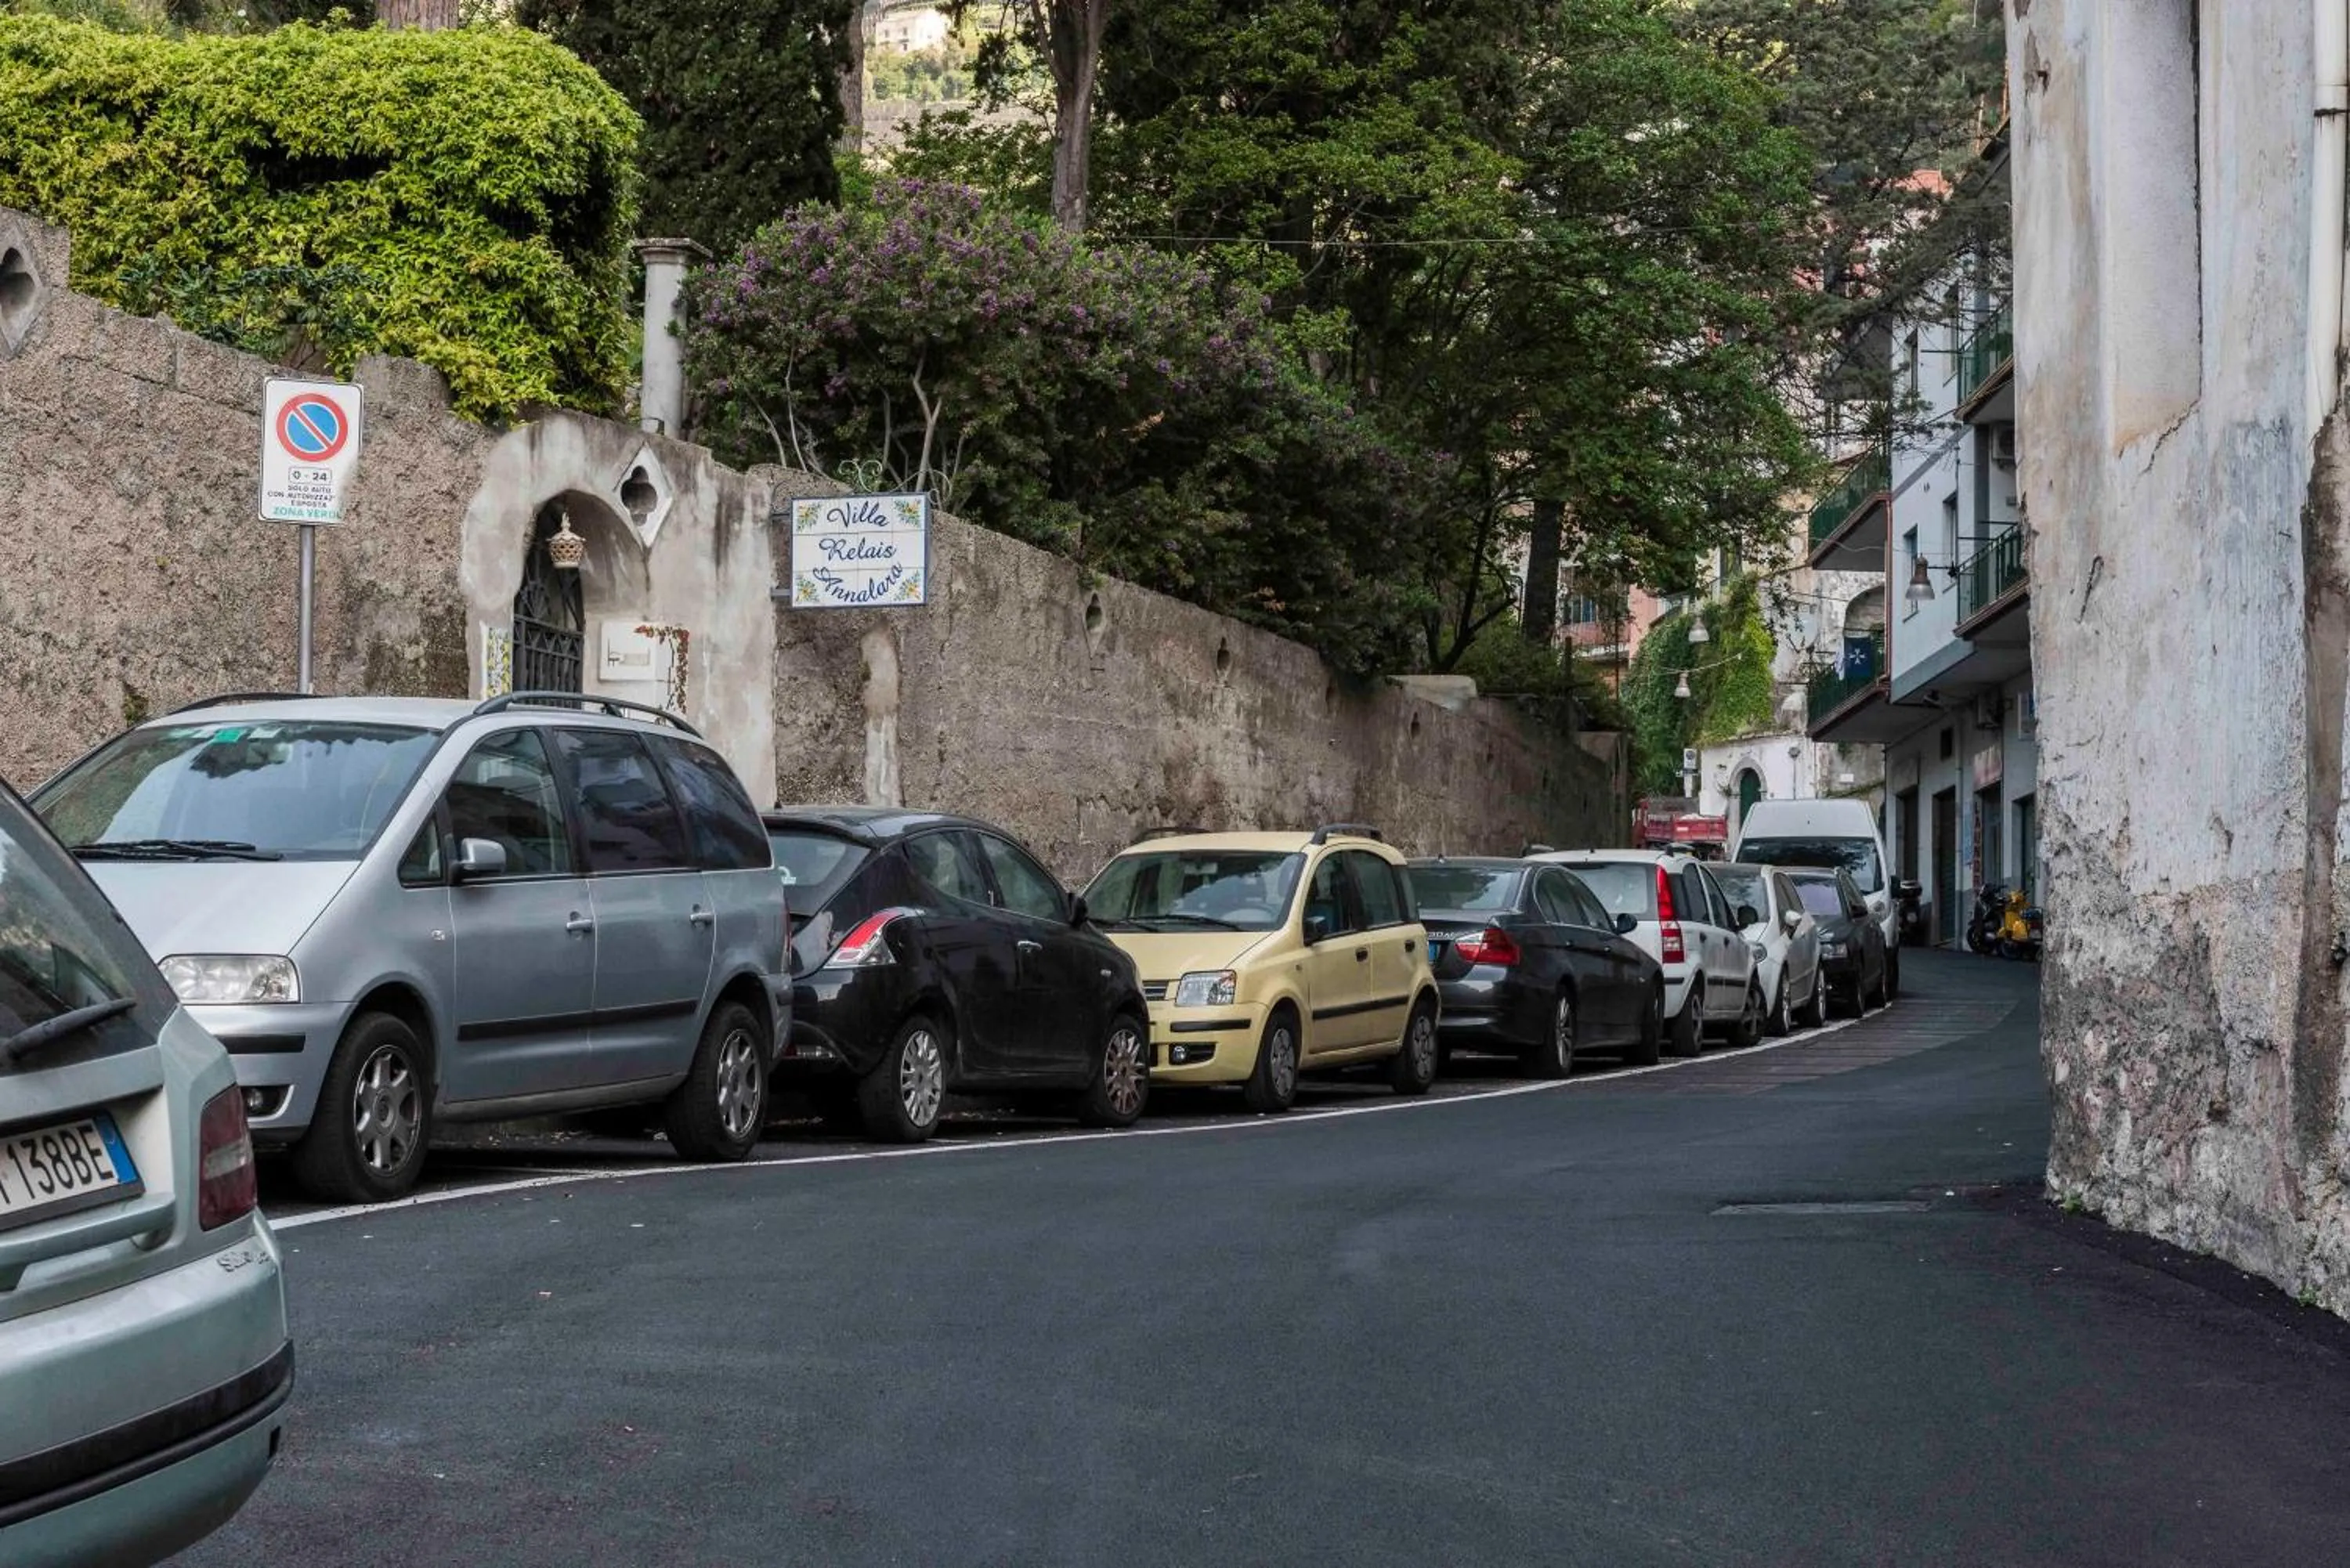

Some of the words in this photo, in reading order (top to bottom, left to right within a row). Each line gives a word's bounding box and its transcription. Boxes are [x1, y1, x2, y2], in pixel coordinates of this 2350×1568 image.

[313, 471, 327, 481] 24
[273, 505, 304, 516] ZONA
[826, 500, 890, 529] Villa
[819, 537, 897, 562] Relais
[0, 1124, 115, 1204] 138BE
